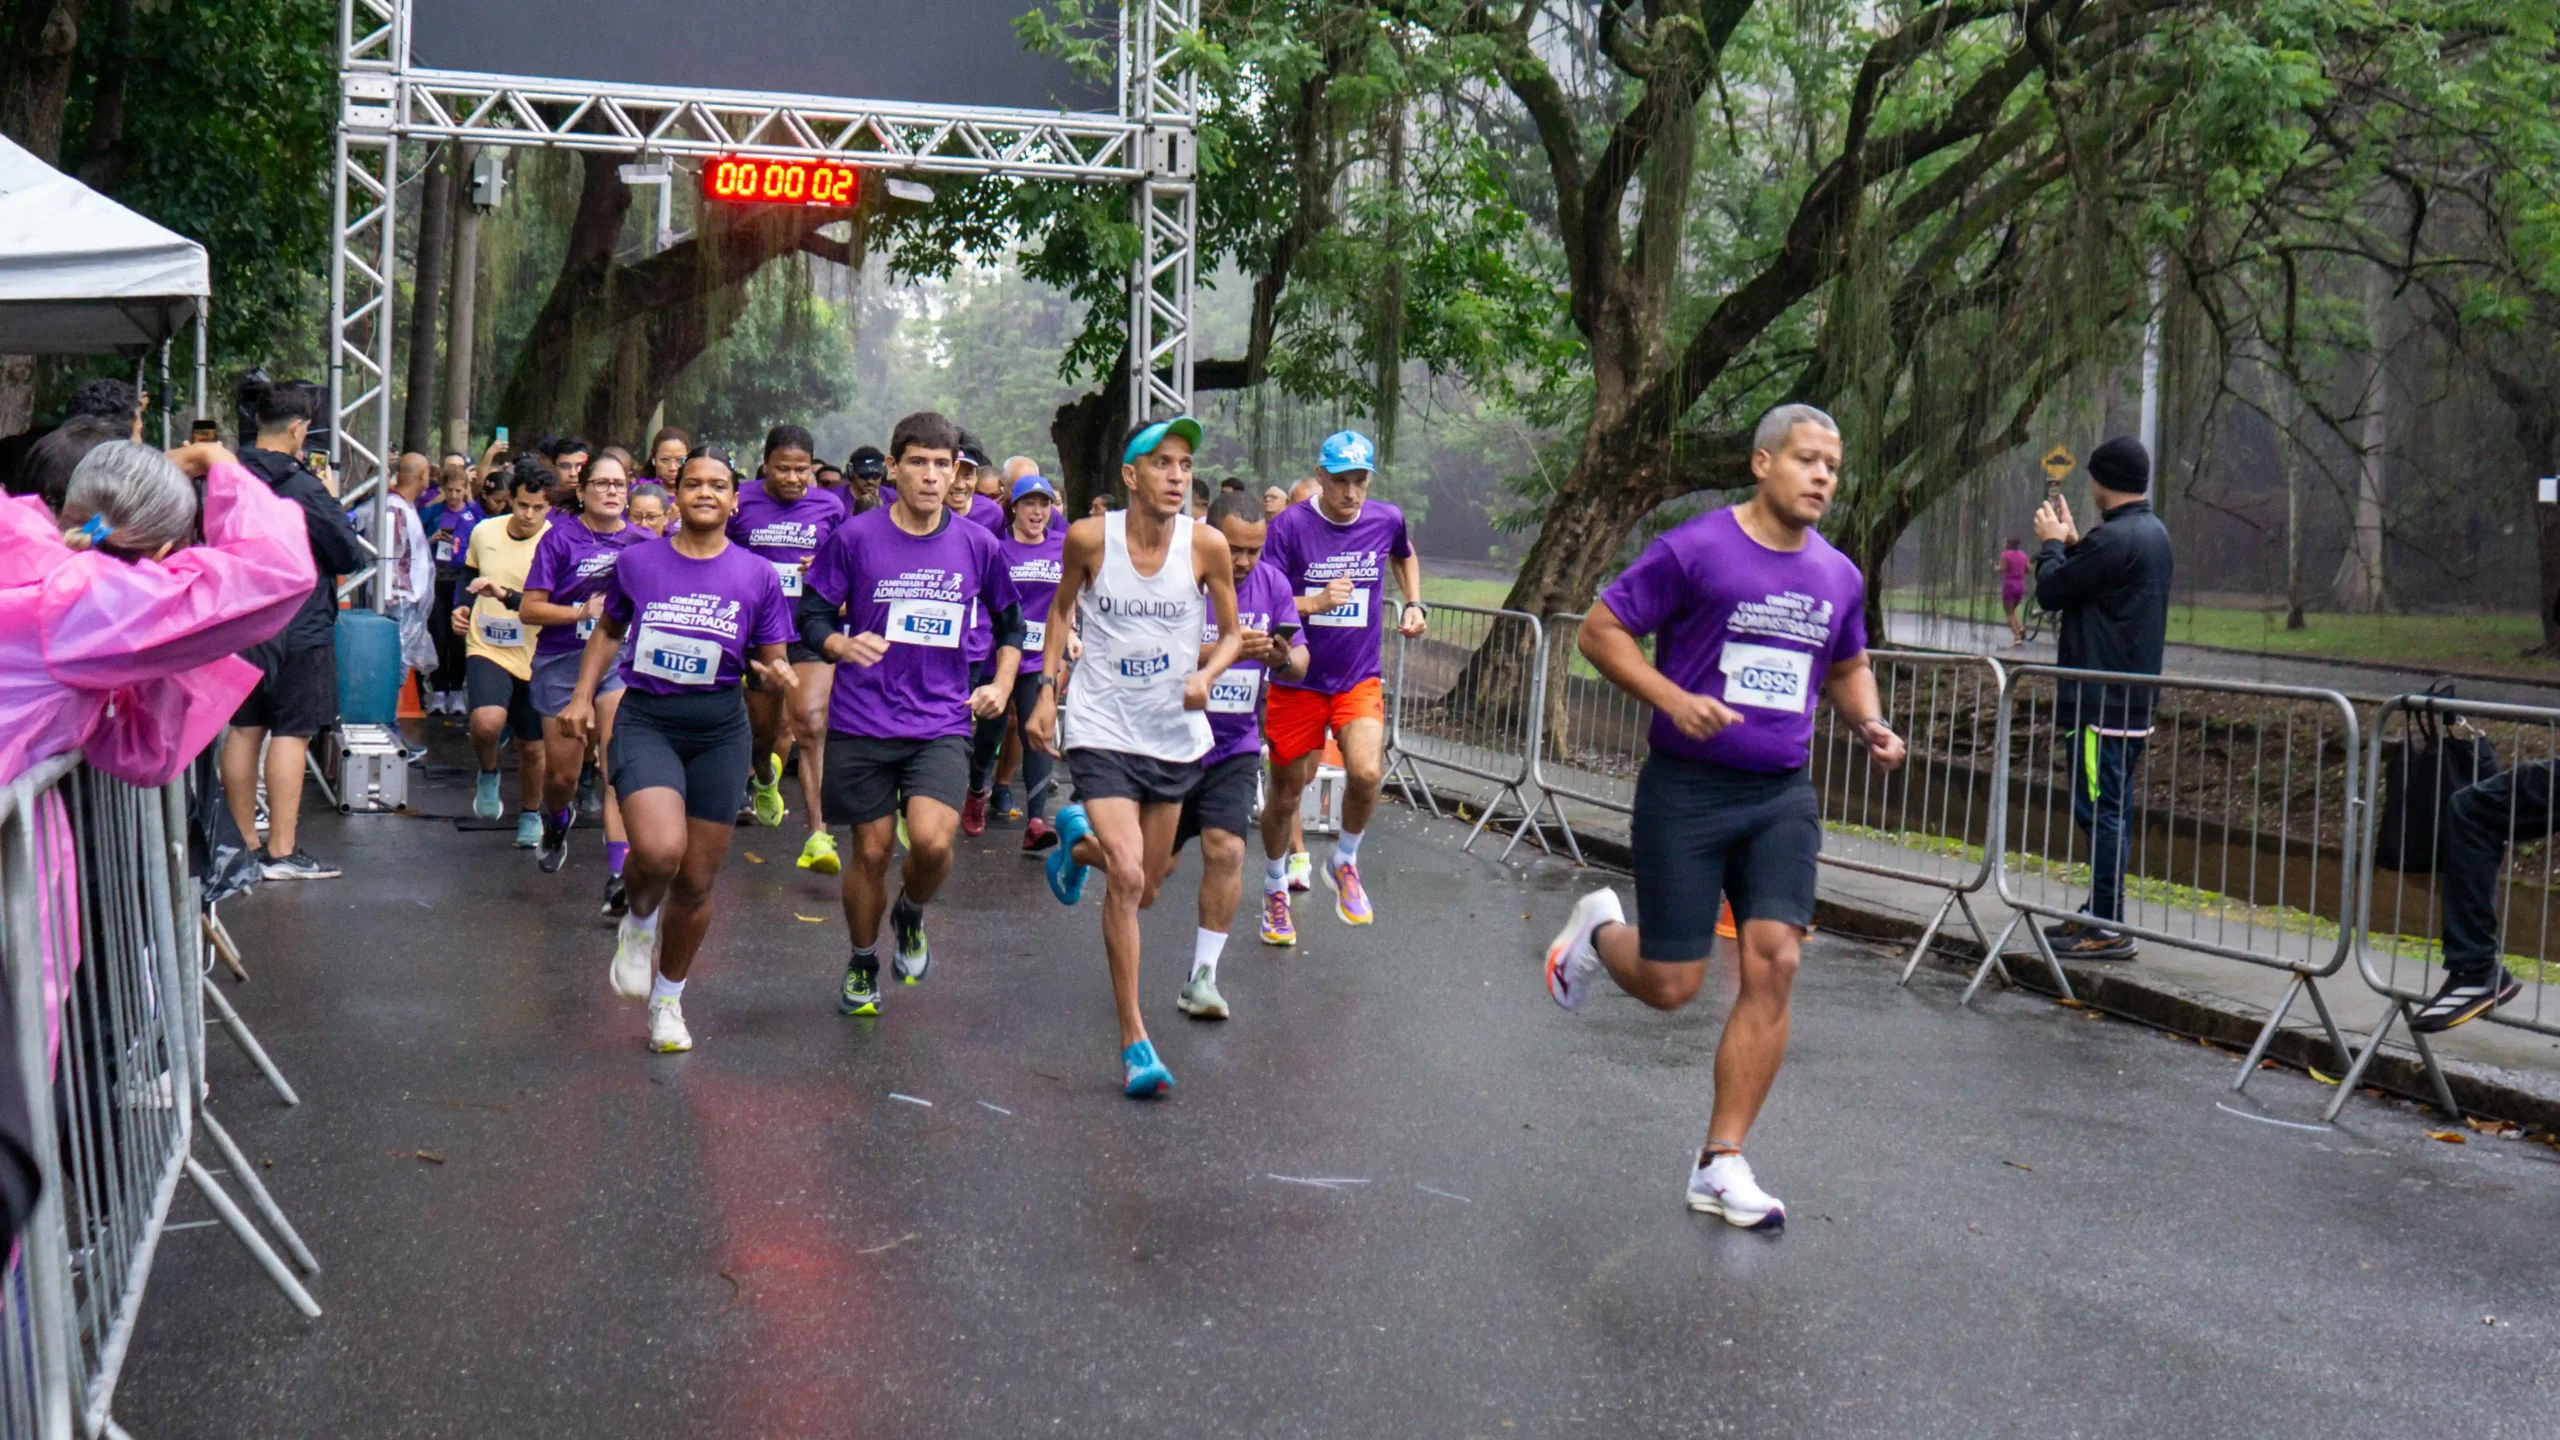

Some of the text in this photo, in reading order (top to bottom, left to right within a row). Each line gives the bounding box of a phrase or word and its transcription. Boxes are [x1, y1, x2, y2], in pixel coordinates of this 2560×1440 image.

[715, 162, 853, 201] 00 00 02
[641, 611, 738, 634] ADMINISTRADOR
[913, 617, 945, 634] 1521
[661, 652, 698, 673] 1116
[1124, 655, 1166, 675] 1584
[1211, 685, 1250, 701] 0427
